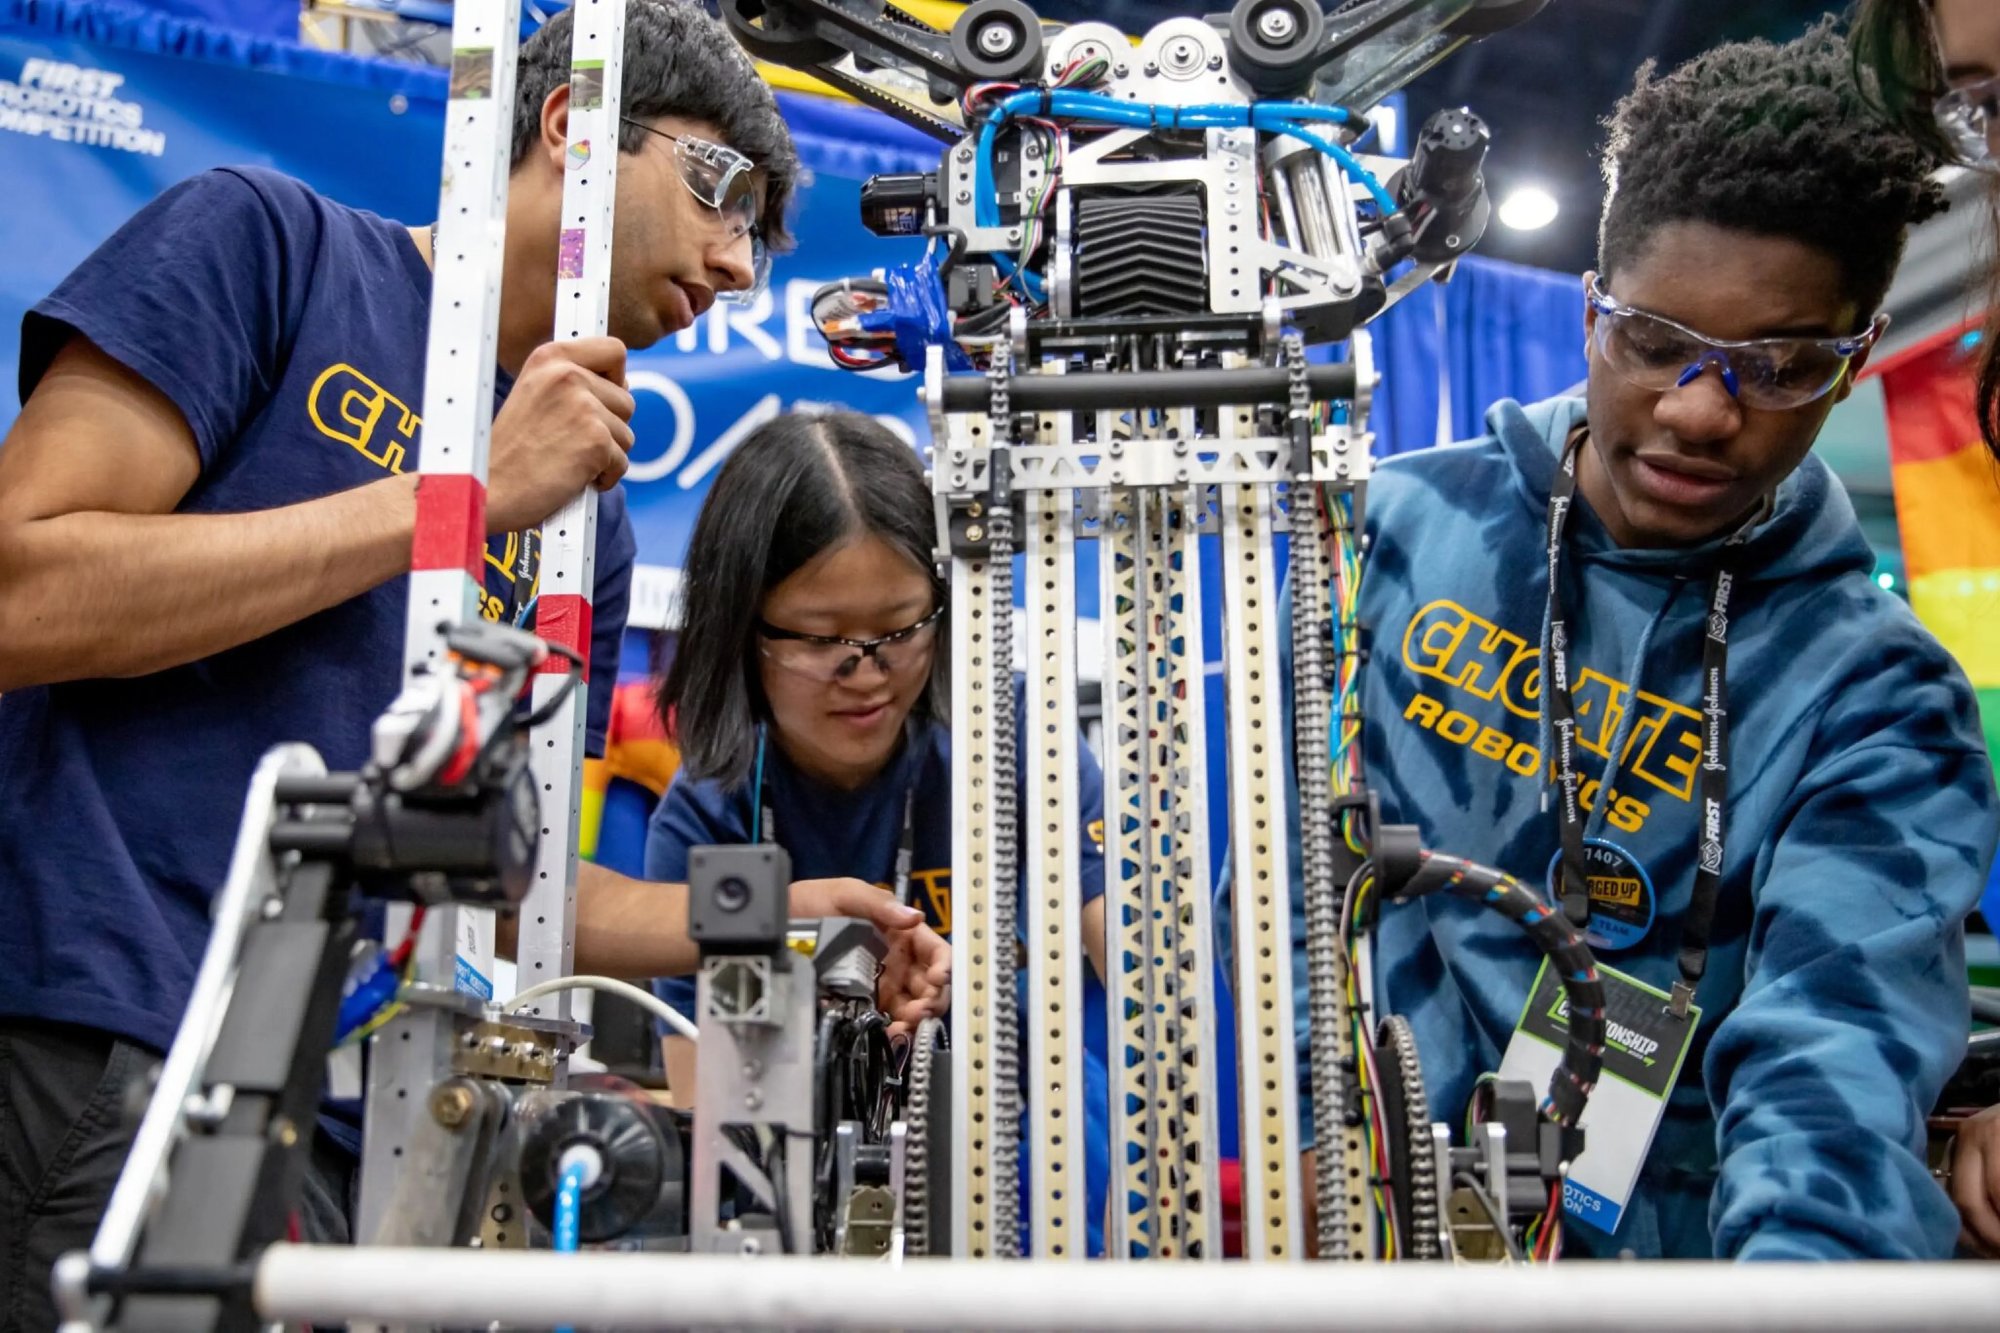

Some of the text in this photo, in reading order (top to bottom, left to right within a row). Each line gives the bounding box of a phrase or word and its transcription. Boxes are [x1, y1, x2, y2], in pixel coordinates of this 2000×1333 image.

[19, 57, 125, 99] FIRST
[1714, 570, 1733, 613] FIRST
[1554, 651, 1567, 692] FIRST
[1402, 599, 1703, 802] CHOATE
[1403, 693, 1650, 833] ROBOCS
[1706, 798, 1721, 841] FIRST
[1621, 881, 1638, 899] UP
[1563, 1184, 1601, 1212] OTICS
